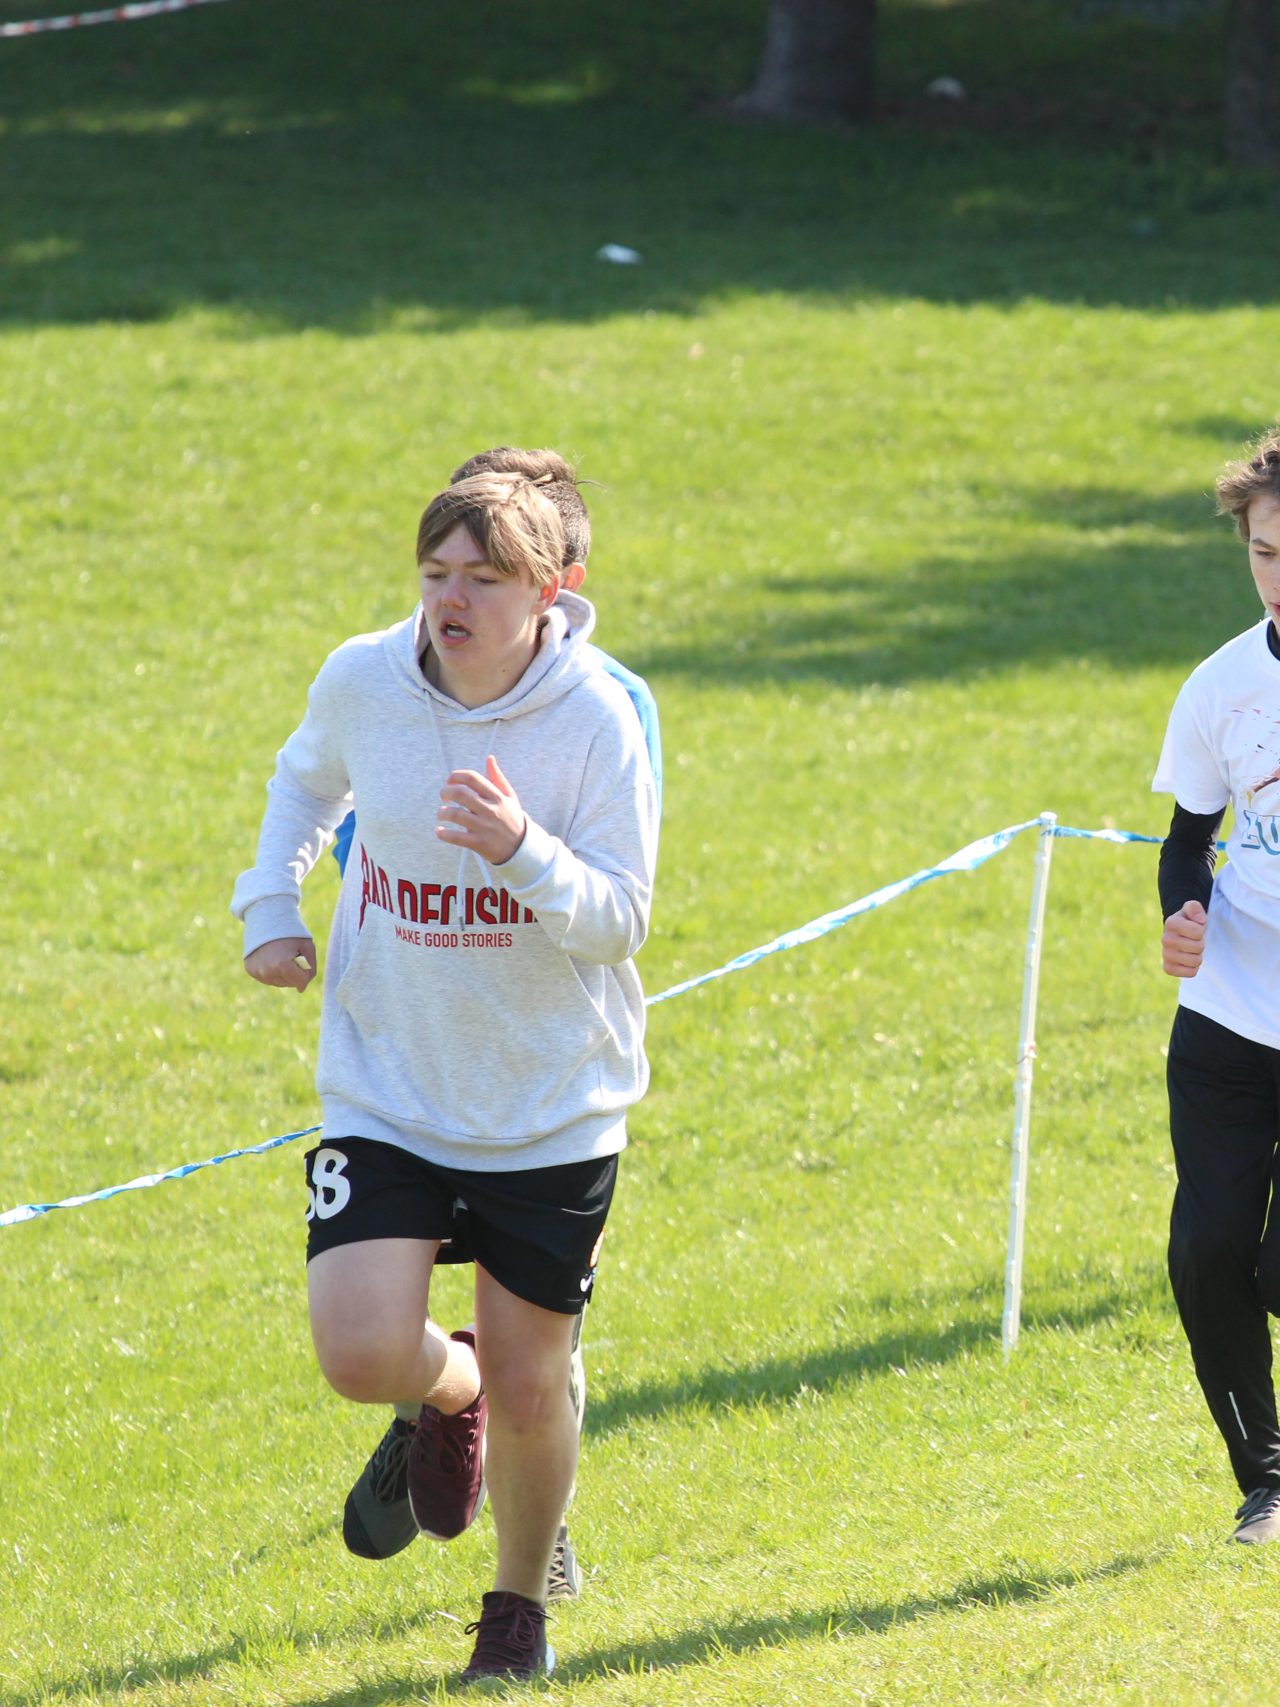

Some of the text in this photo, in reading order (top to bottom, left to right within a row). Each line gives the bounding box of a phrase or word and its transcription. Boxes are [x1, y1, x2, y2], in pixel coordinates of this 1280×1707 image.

[395, 925, 512, 948] MAKE GOOD STORIES
